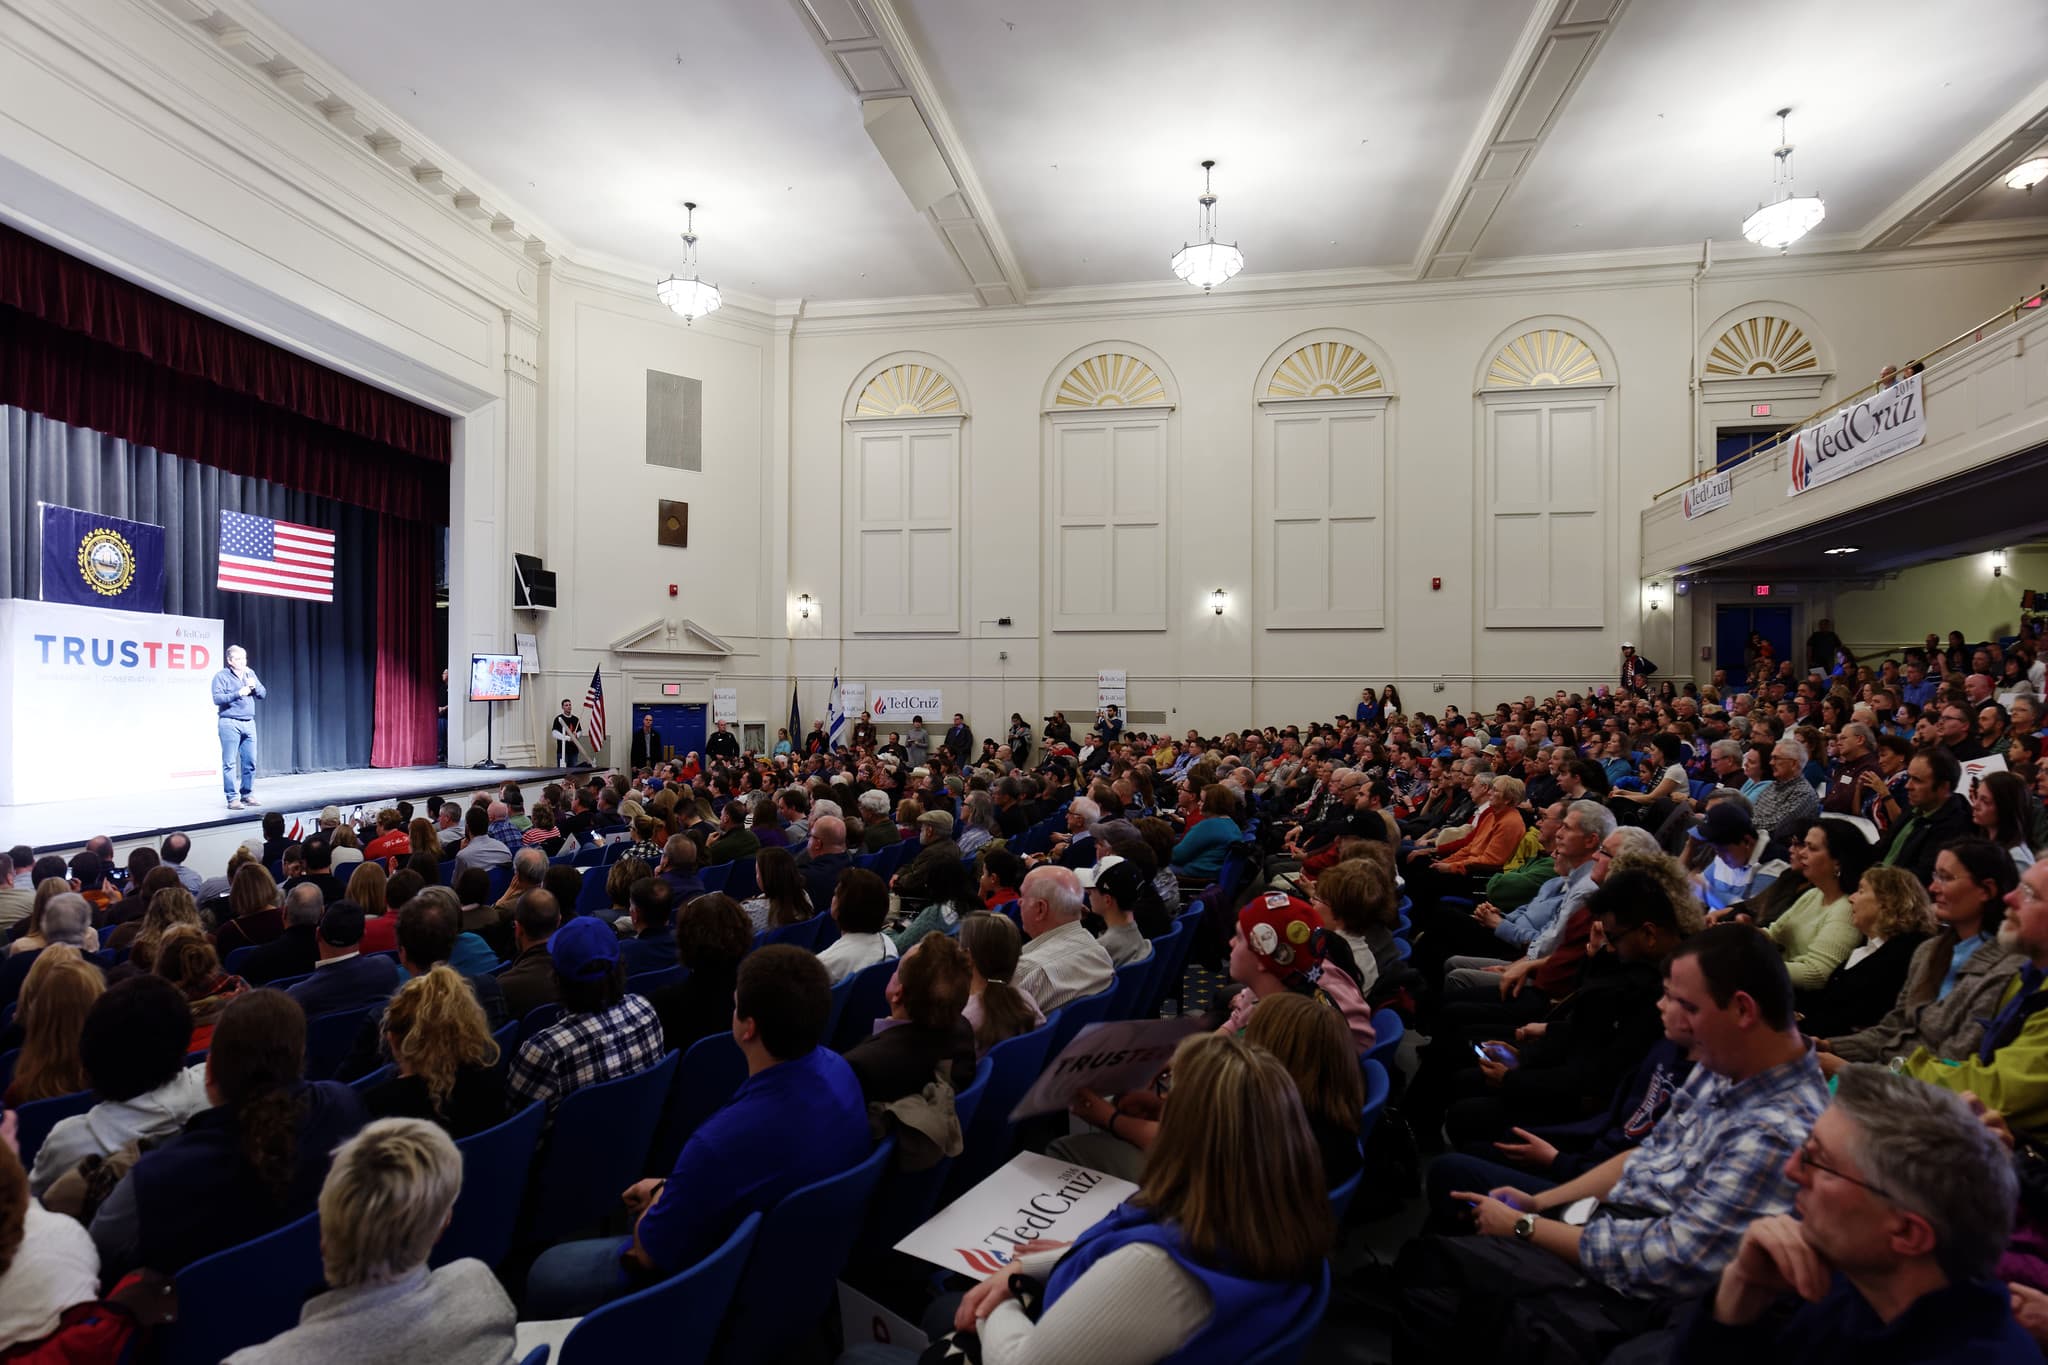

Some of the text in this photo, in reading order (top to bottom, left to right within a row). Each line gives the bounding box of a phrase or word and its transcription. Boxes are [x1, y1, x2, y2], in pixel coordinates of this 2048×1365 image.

[1811, 393, 1917, 463] TedCruz
[1691, 480, 1729, 506] TedCruz
[34, 634, 210, 670] TRUSTED
[887, 696, 939, 709] TedCruz
[983, 1171, 1103, 1247] TedCruz
